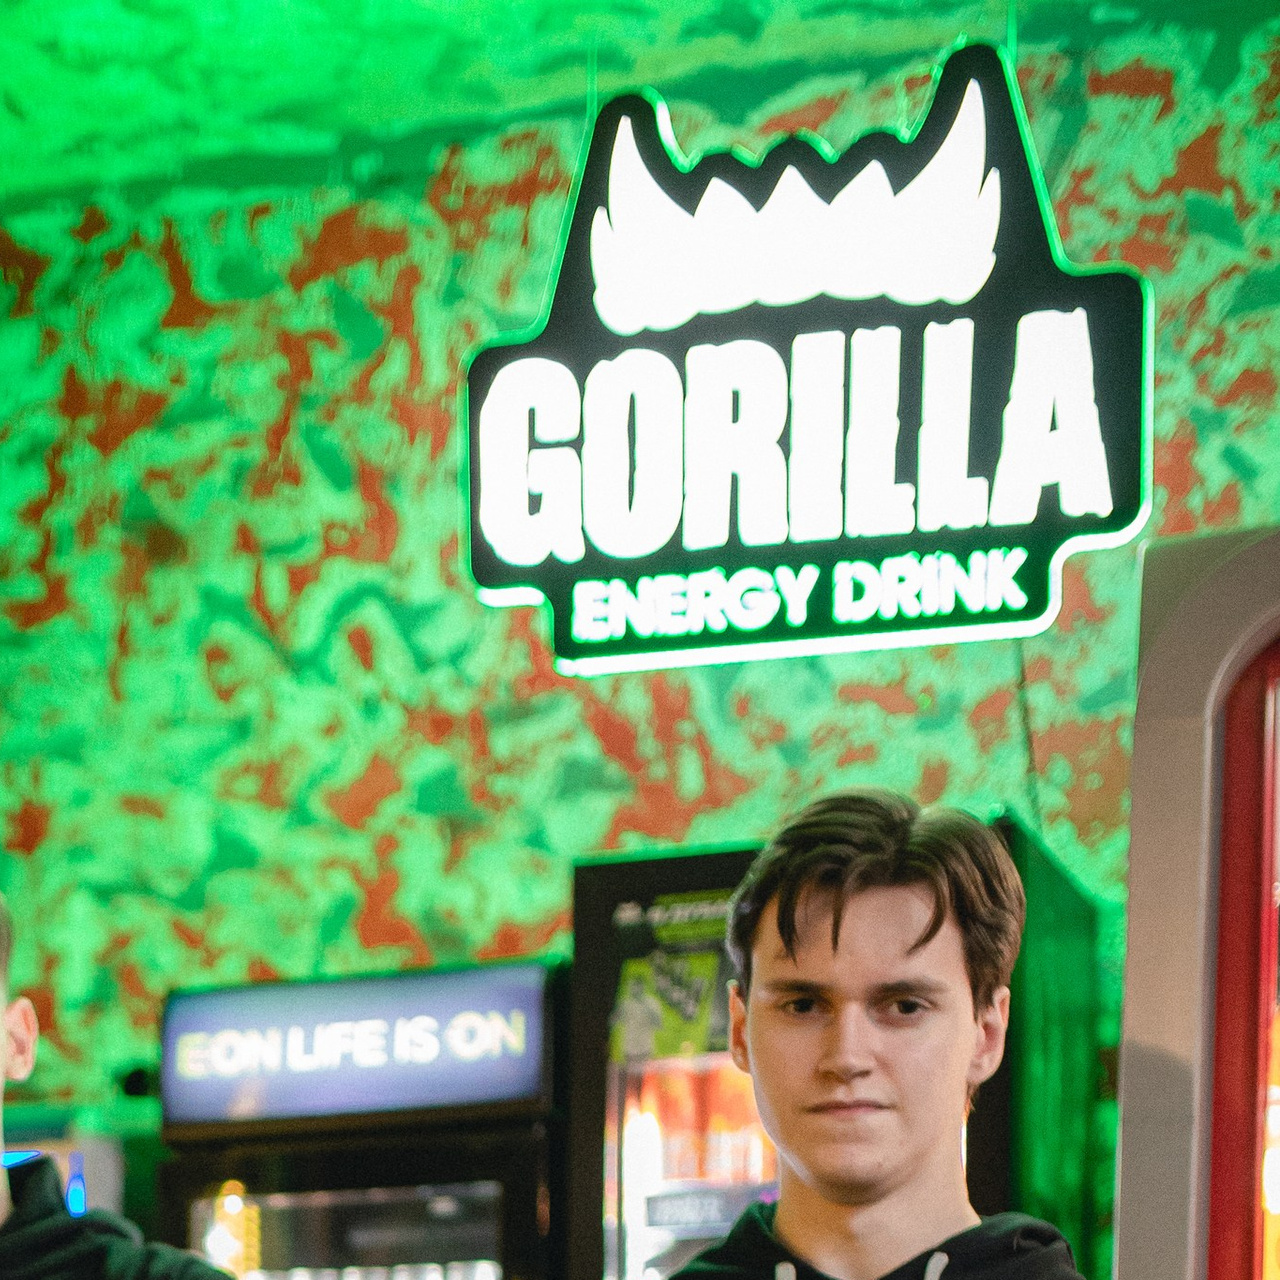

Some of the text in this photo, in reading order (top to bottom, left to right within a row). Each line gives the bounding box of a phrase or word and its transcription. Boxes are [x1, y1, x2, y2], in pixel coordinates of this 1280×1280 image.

[478, 307, 1113, 567] GORILLA
[572, 547, 1028, 643] ENERGY DRINK
[285, 1018, 390, 1073] LIFE
[392, 1013, 441, 1065] IS
[443, 1008, 526, 1063] ON
